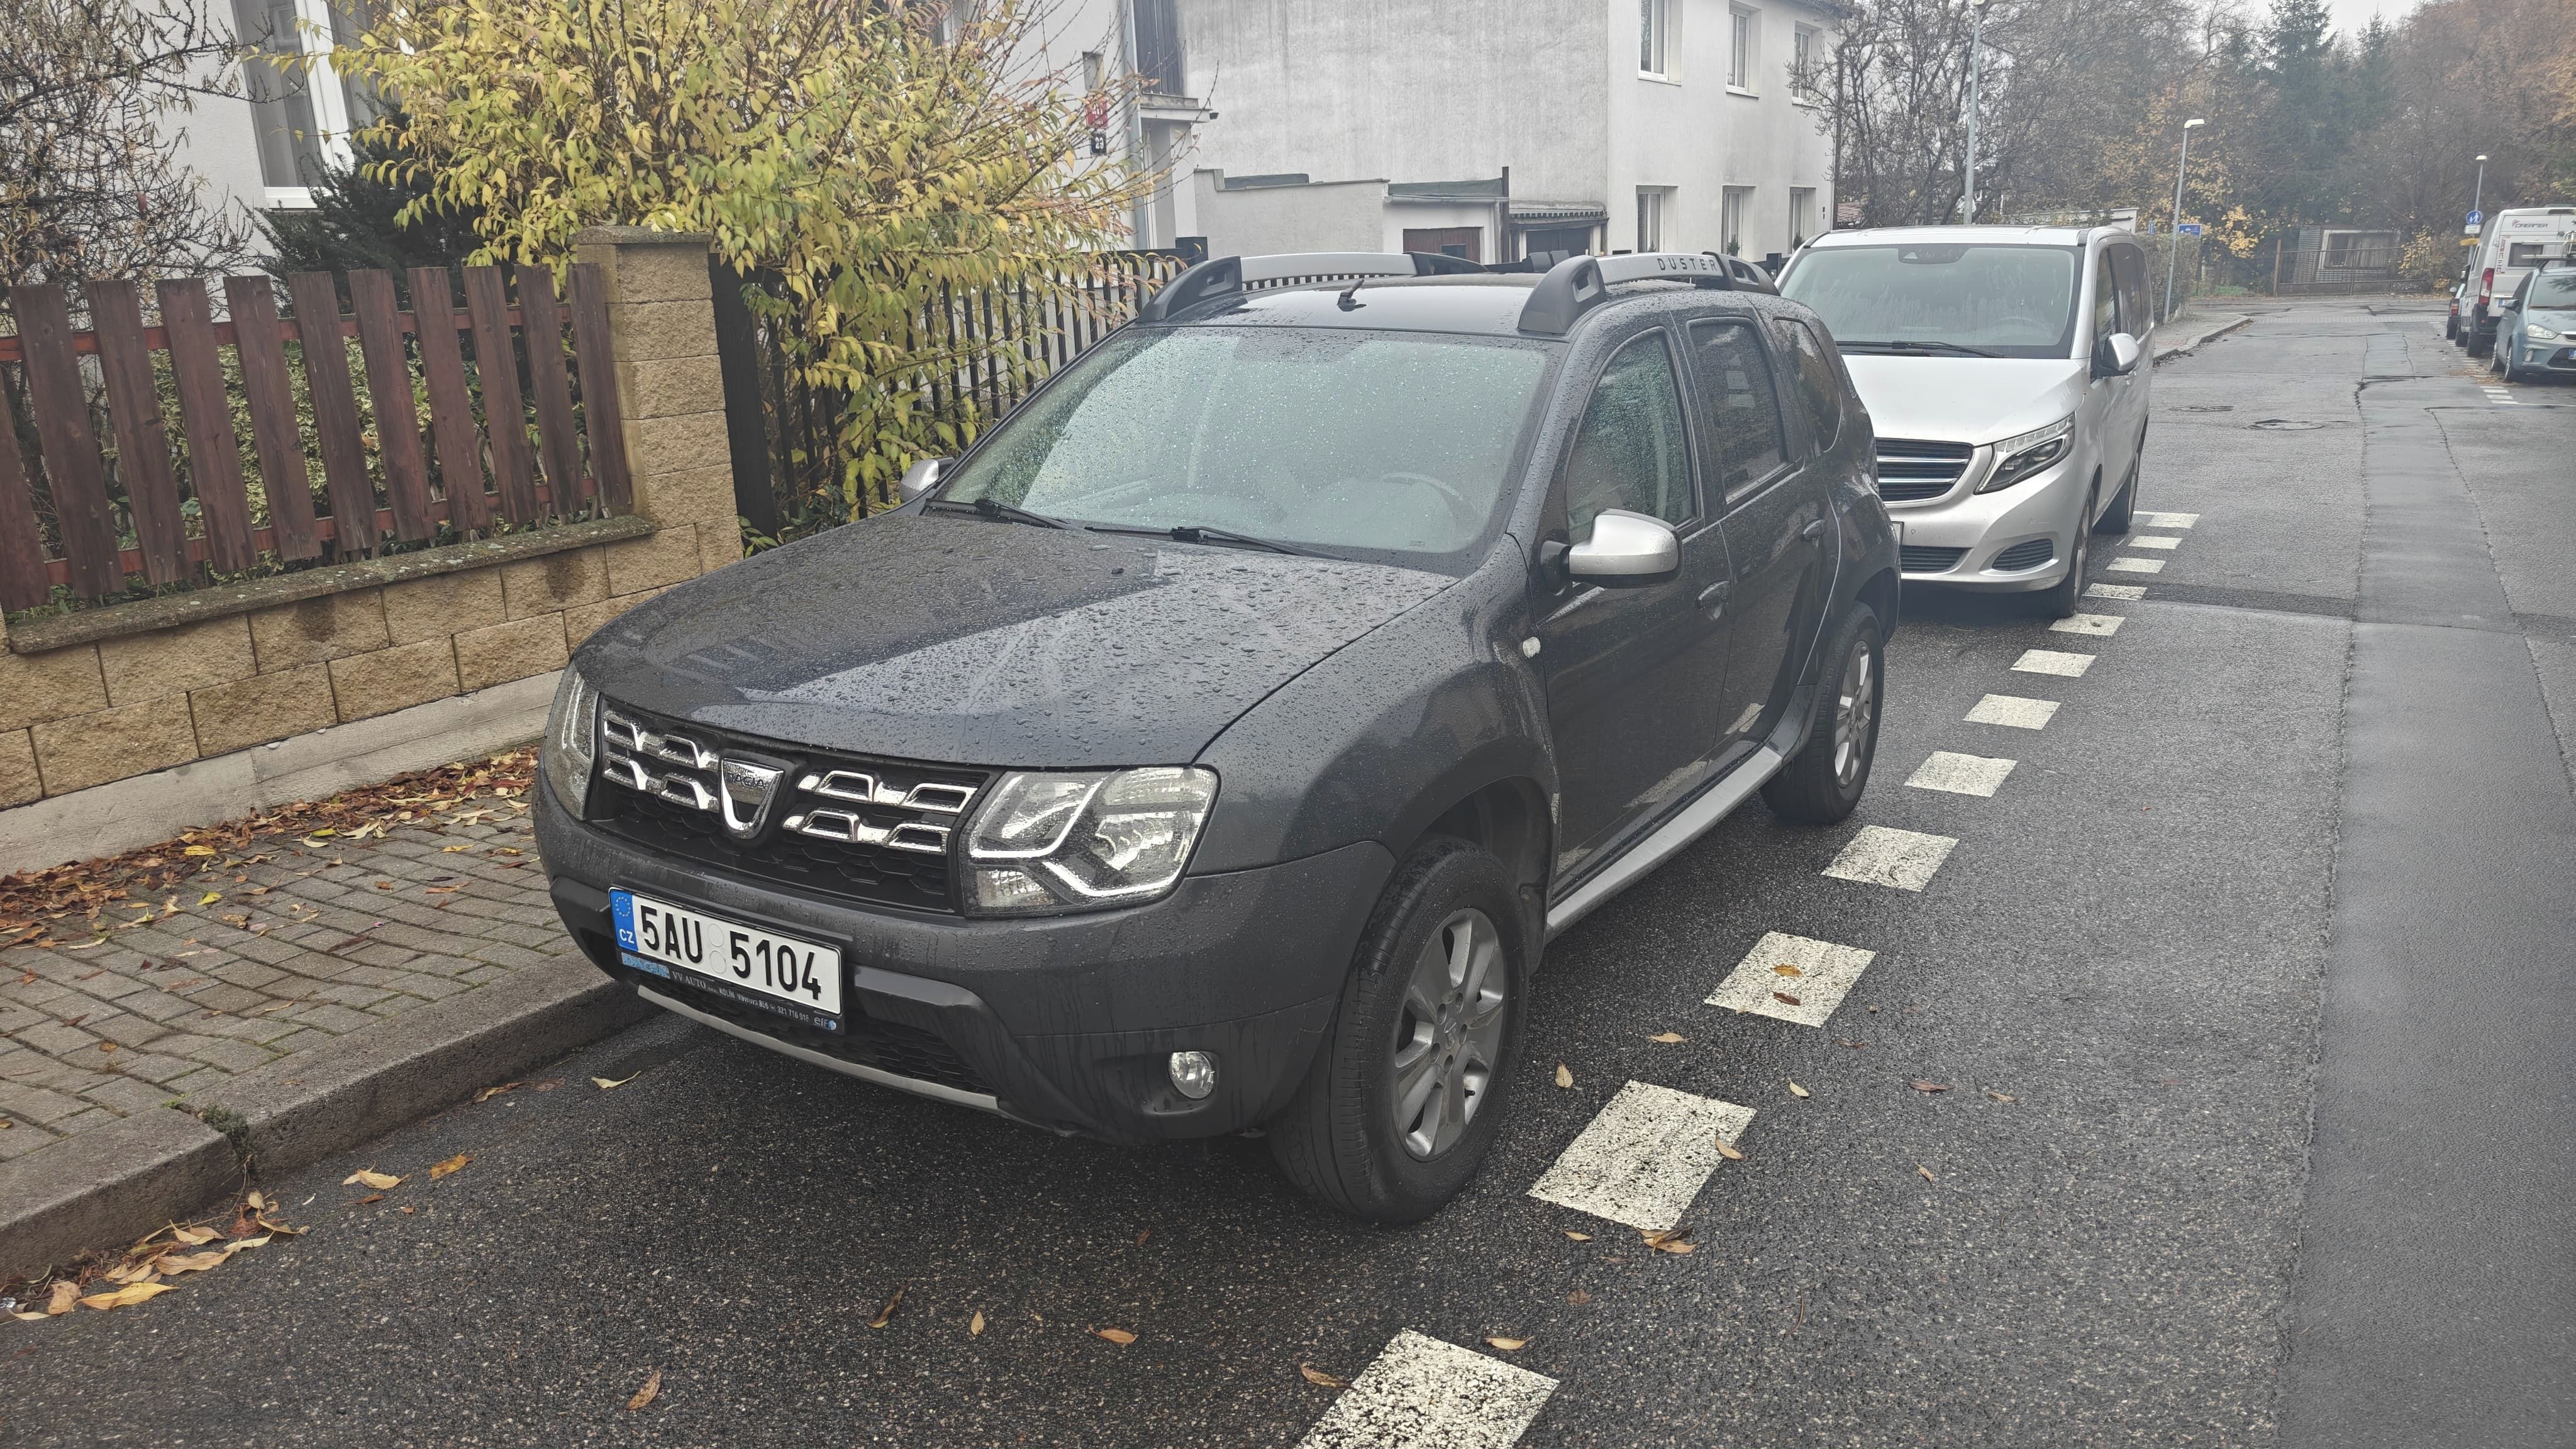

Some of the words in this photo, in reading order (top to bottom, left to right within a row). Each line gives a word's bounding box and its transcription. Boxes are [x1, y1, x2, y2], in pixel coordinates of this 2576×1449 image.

[1095, 136, 1104, 150] 23
[1657, 257, 1718, 272] DUSTER
[619, 928, 635, 944] CZ
[640, 904, 702, 963] 5AU
[730, 930, 821, 1001] 5104
[672, 970, 683, 982] VV
[684, 976, 706, 989] AUTO
